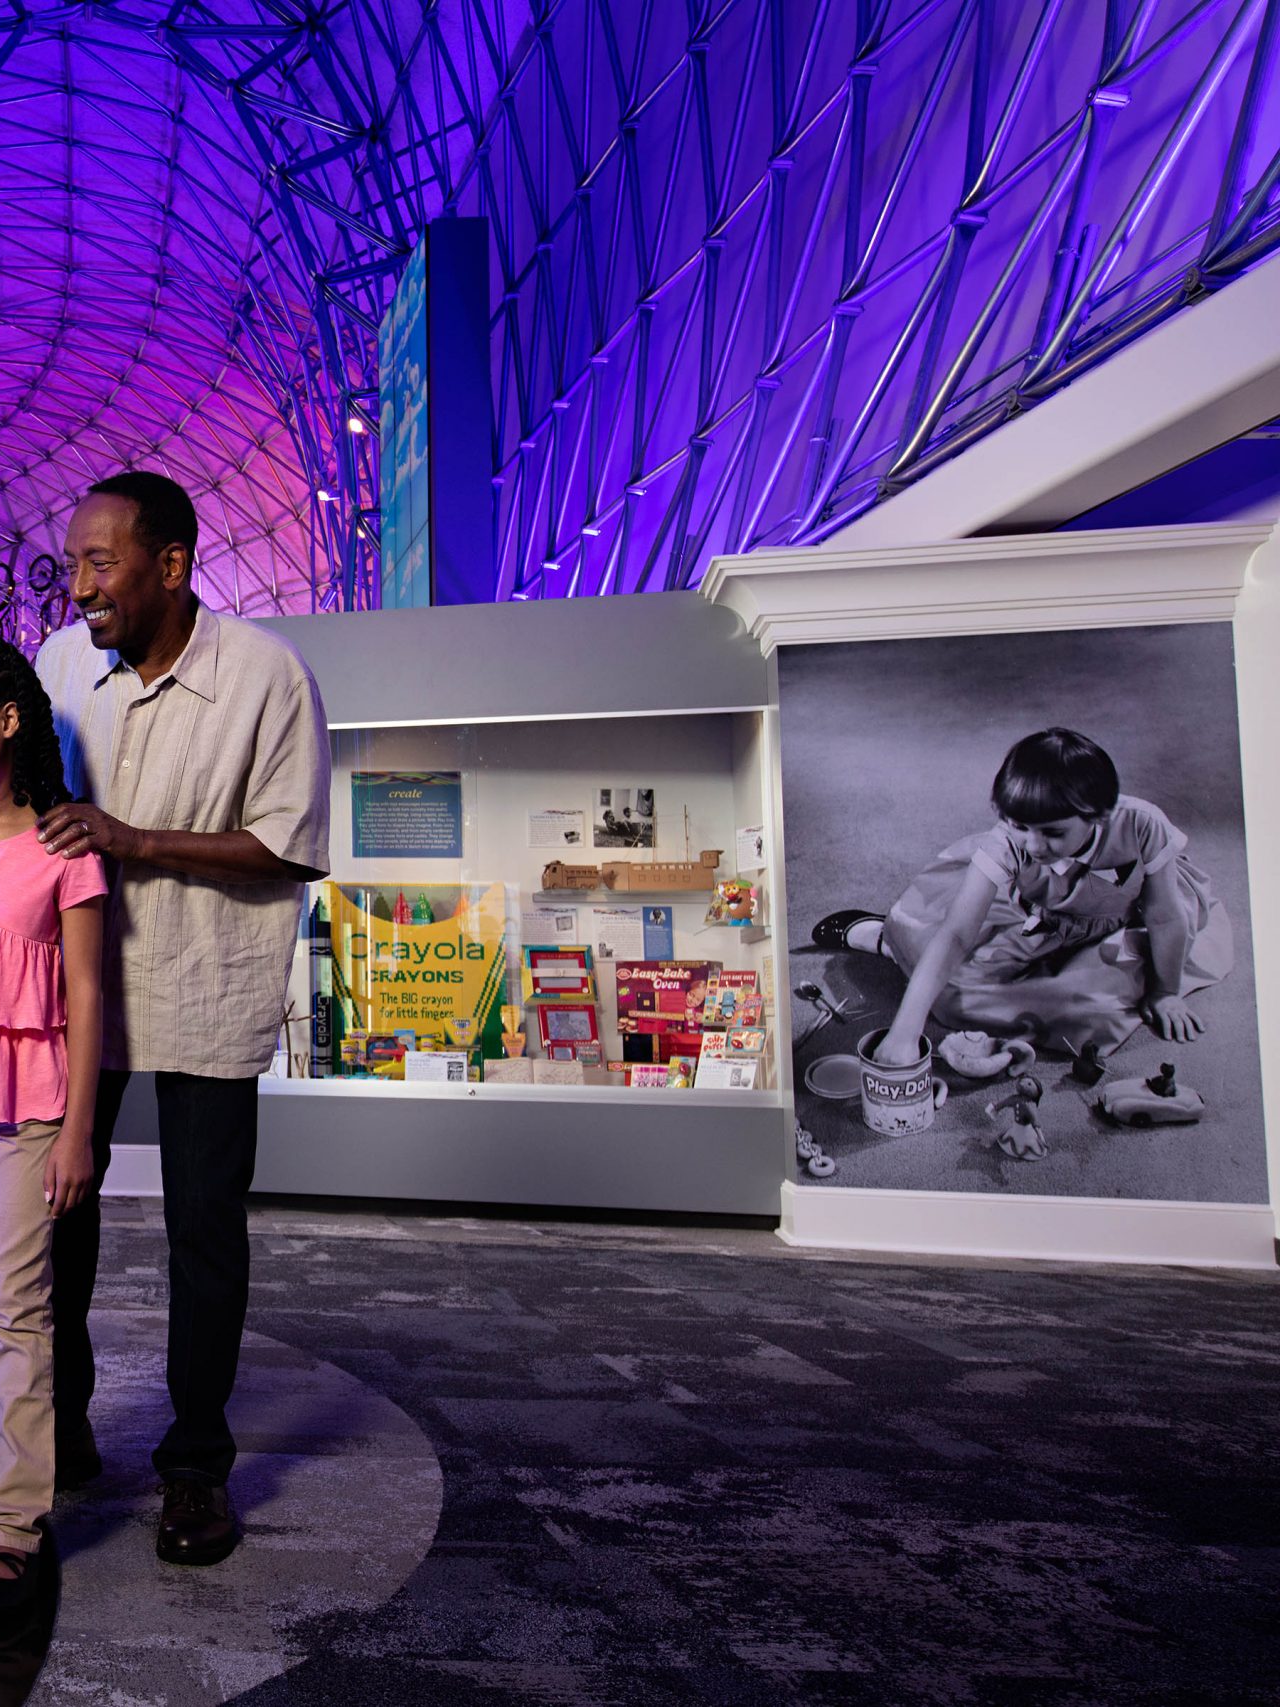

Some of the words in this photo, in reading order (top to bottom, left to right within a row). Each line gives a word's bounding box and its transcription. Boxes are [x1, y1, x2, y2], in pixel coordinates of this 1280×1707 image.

[388, 788, 423, 799] create
[346, 933, 485, 965] Crayola
[365, 969, 464, 984] CRAYONS
[631, 967, 691, 981] Easy-Bake
[652, 978, 680, 990] Oven
[380, 992, 398, 1004] The
[401, 992, 418, 1004] BIG
[421, 995, 453, 1008] crayon
[380, 1006, 395, 1018] for
[396, 1006, 418, 1018] little
[866, 1072, 931, 1100] Play-Doh
